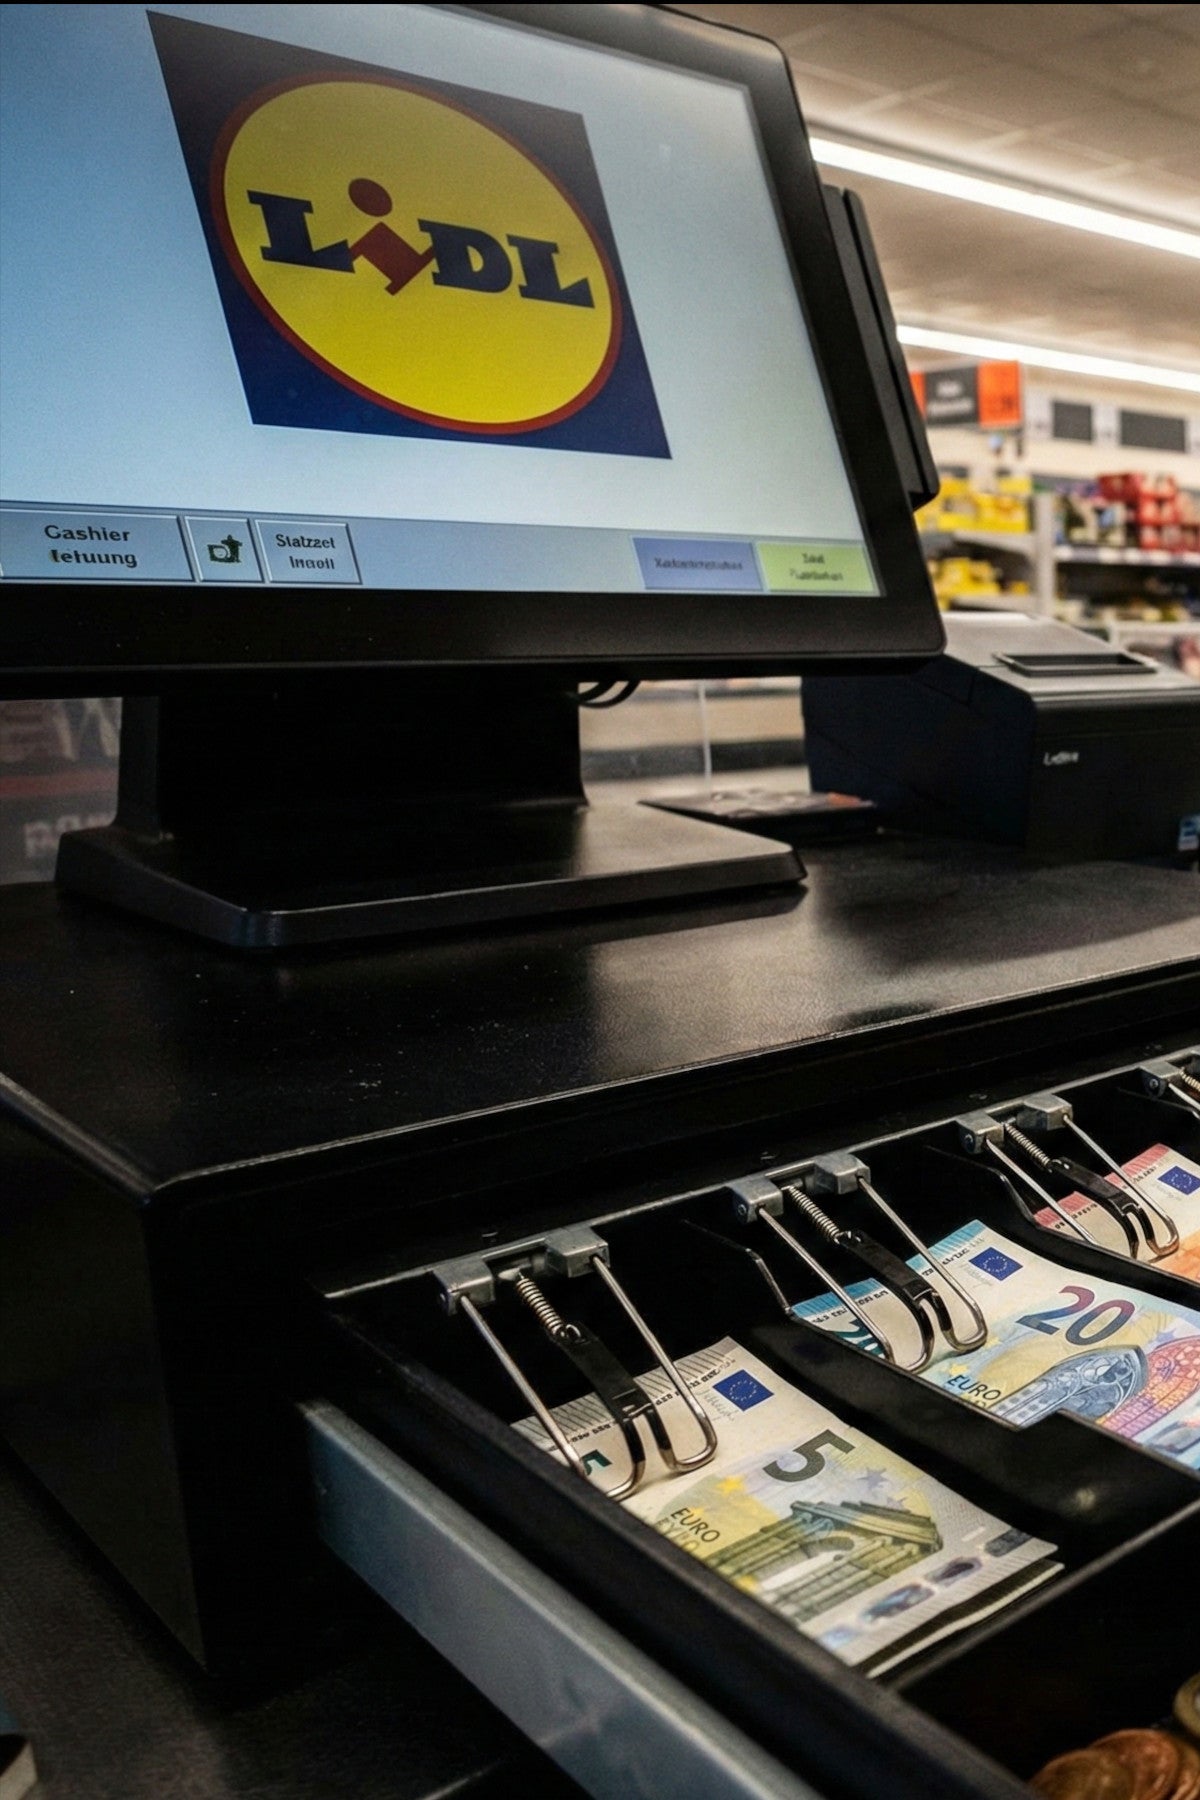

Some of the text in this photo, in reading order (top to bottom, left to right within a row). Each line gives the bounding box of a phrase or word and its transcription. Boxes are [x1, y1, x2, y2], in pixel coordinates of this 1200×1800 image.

[1015, 1285, 1135, 1346] 20
[947, 1374, 1002, 1401] EURO
[762, 1428, 857, 1485] 5
[670, 1507, 721, 1543] EURO
